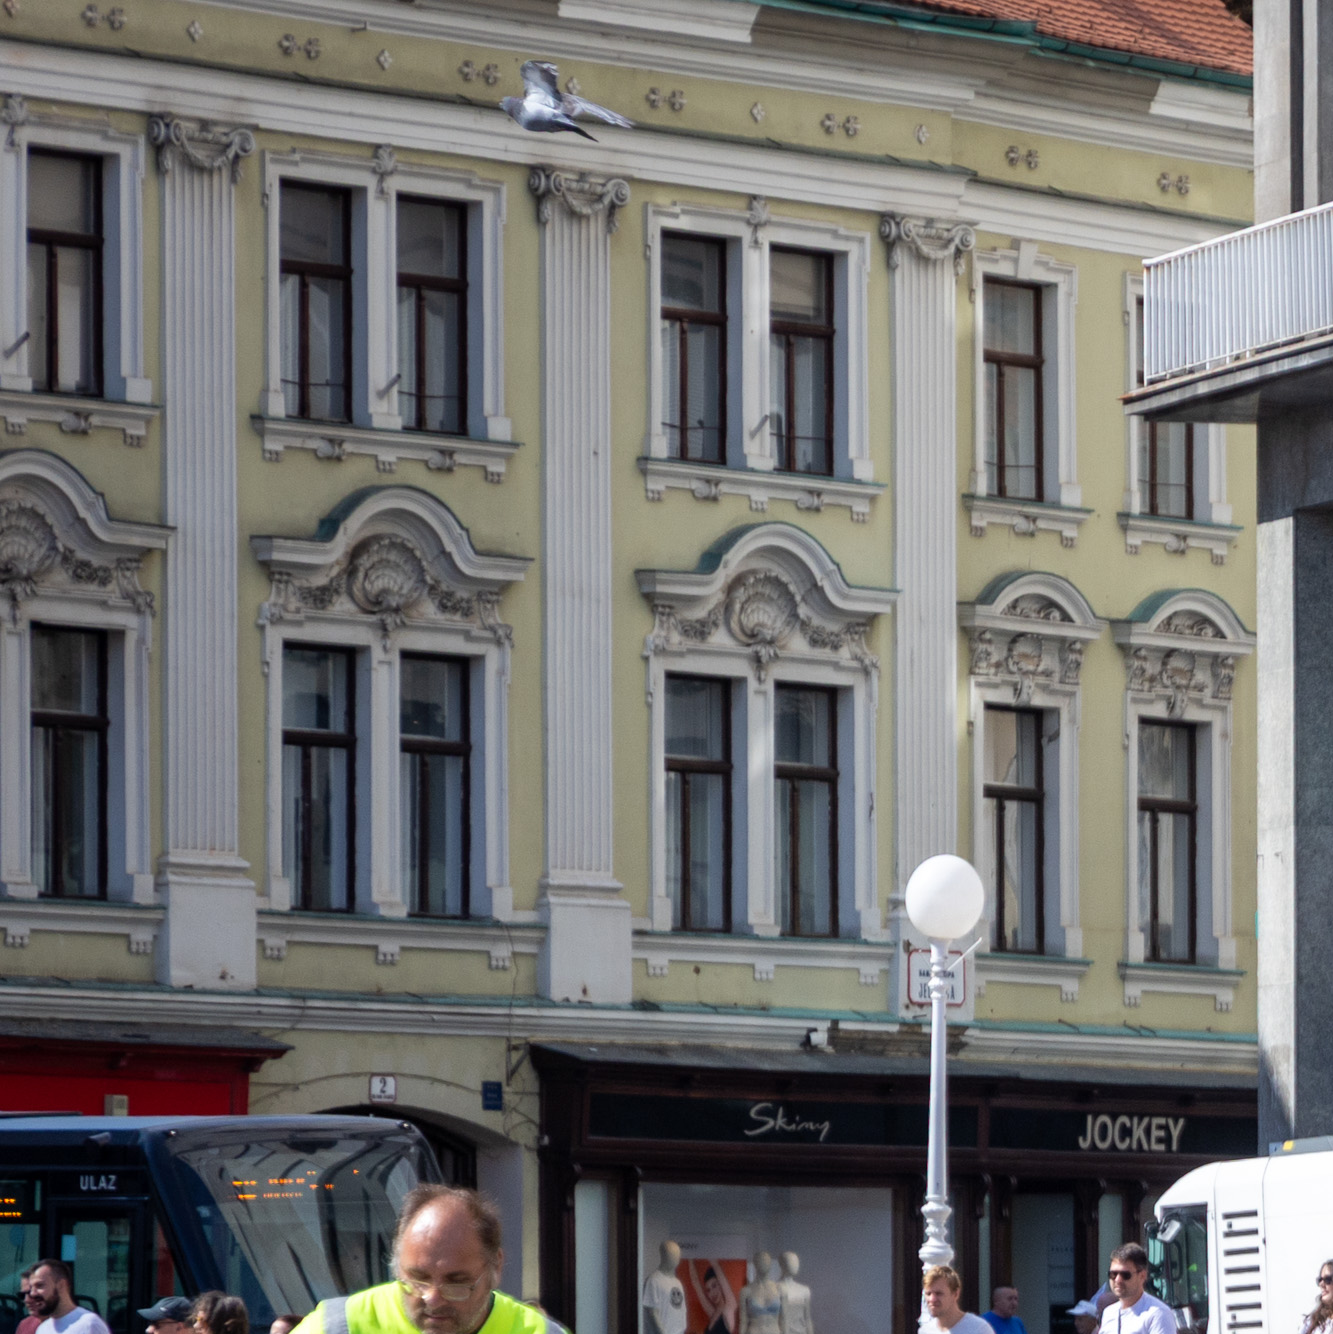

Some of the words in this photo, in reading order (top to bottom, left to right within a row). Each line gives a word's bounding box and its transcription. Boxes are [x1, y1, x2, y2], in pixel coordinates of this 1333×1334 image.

[380, 1077, 387, 1094] 2
[1079, 1114, 1185, 1152] JOCKEY
[80, 1175, 117, 1190] ULAZ
